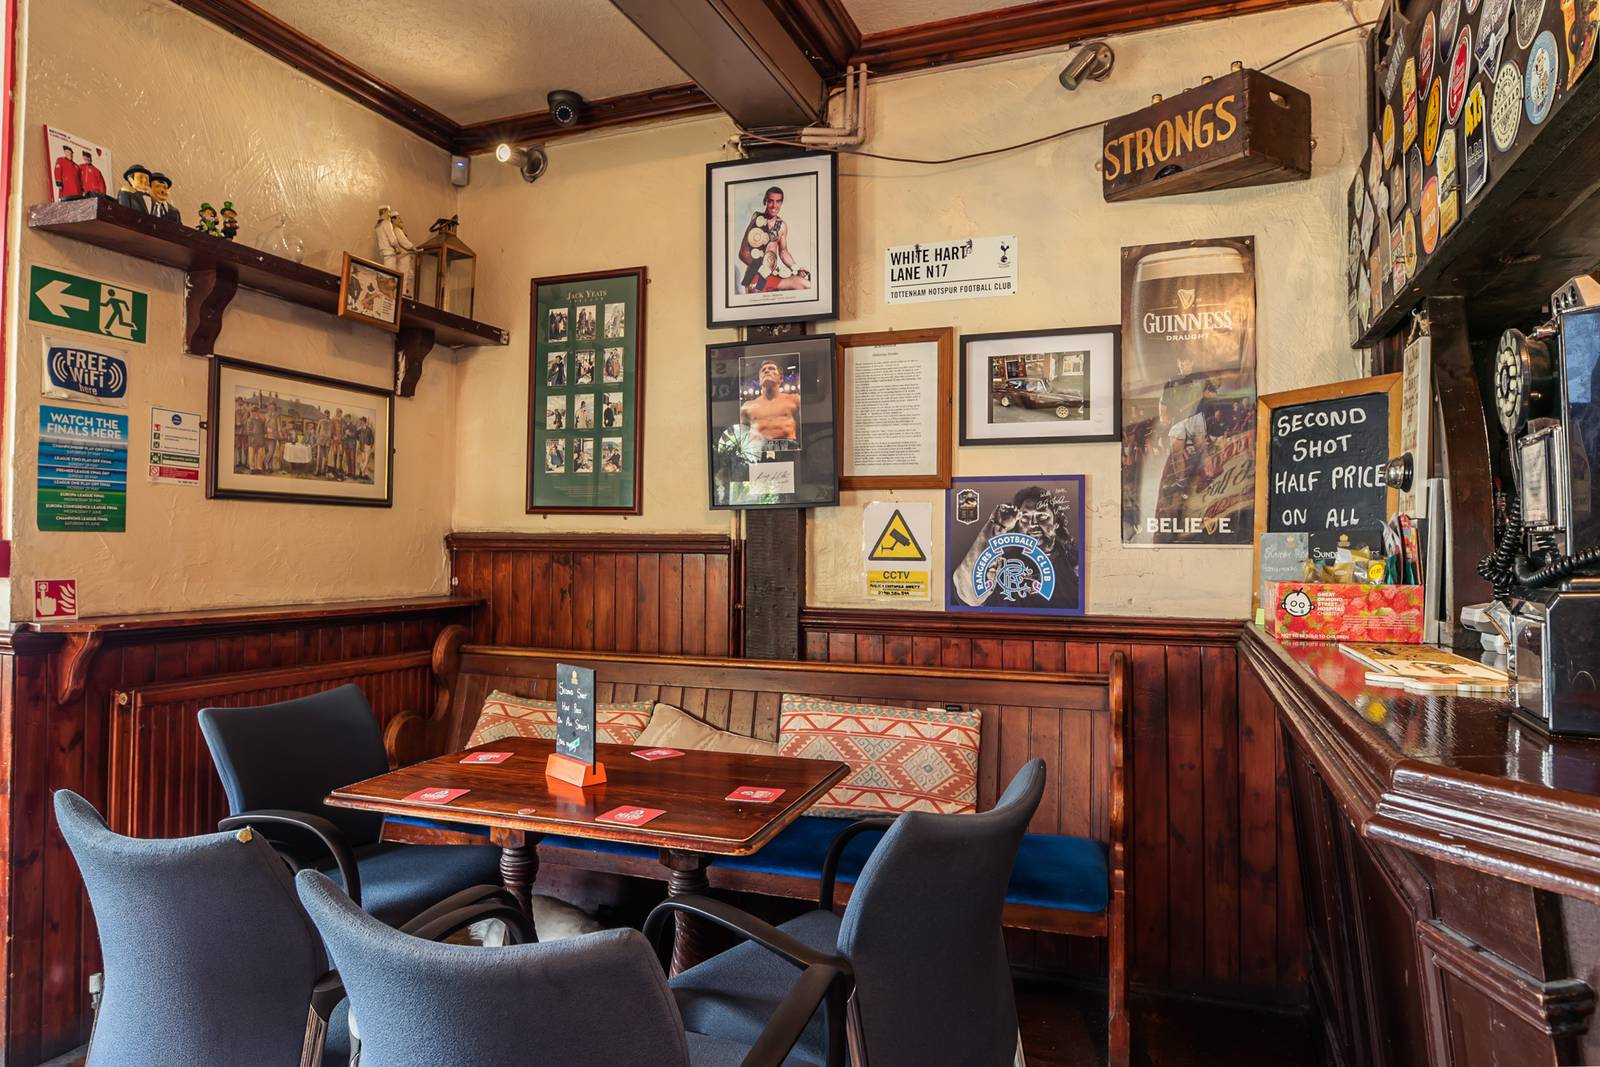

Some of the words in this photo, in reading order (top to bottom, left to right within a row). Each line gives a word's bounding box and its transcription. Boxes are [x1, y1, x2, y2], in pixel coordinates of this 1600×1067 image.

[1103, 95, 1237, 181] STRONGS
[890, 248, 930, 266] WHITE
[934, 245, 967, 262] HART
[890, 266, 921, 282] LANE
[926, 263, 948, 279] N17
[890, 288, 927, 299] TOTTENHAM
[928, 286, 958, 296] HOTSPUR
[960, 283, 992, 293] FOOTBALL
[994, 281, 1012, 290] CLUB
[1143, 310, 1232, 334] GUINNESS
[1166, 333, 1210, 341] DRAUGHT
[66, 350, 108, 372] FREE
[69, 366, 104, 388] WiFi
[79, 383, 98, 396] here
[46, 422, 89, 437] FINALS
[91, 427, 121, 440] HERE
[50, 412, 93, 427] WATCH
[96, 417, 119, 430] THE
[1277, 407, 1367, 437] SECOND
[1292, 434, 1352, 462] SHOT
[1275, 470, 1321, 494] HALF
[1331, 463, 1387, 490] PRICE
[1282, 508, 1307, 526] ON
[1326, 508, 1360, 529] ALL
[992, 535, 1034, 548] FOOTBALL
[882, 570, 910, 580] CCTV
[976, 551, 993, 590] RANGERS
[1036, 555, 1052, 582] CLUB
